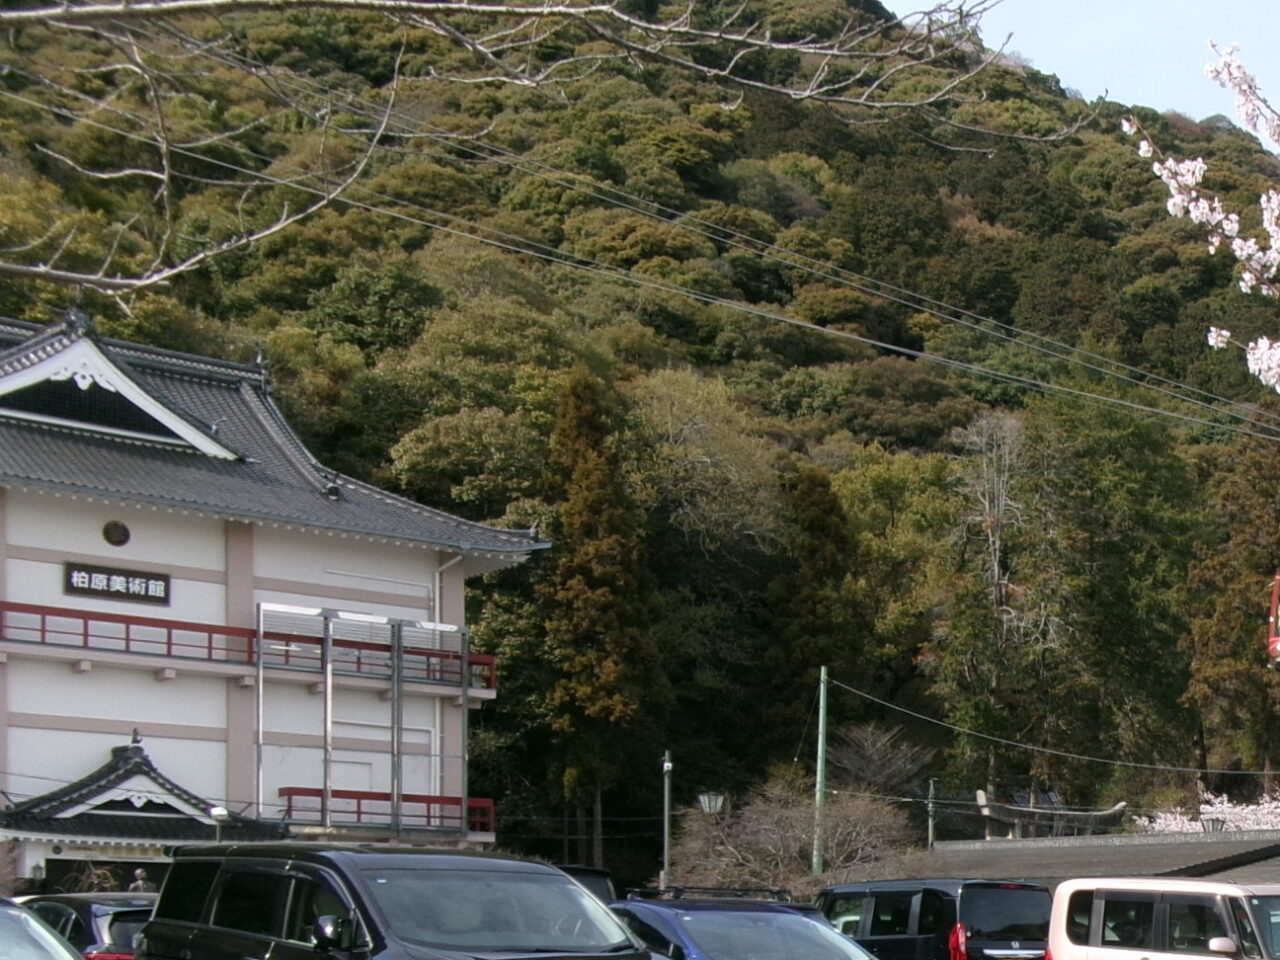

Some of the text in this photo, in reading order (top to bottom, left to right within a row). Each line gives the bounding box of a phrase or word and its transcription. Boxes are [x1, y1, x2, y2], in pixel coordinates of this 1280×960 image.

[71, 570, 166, 597] 柏原美術館
